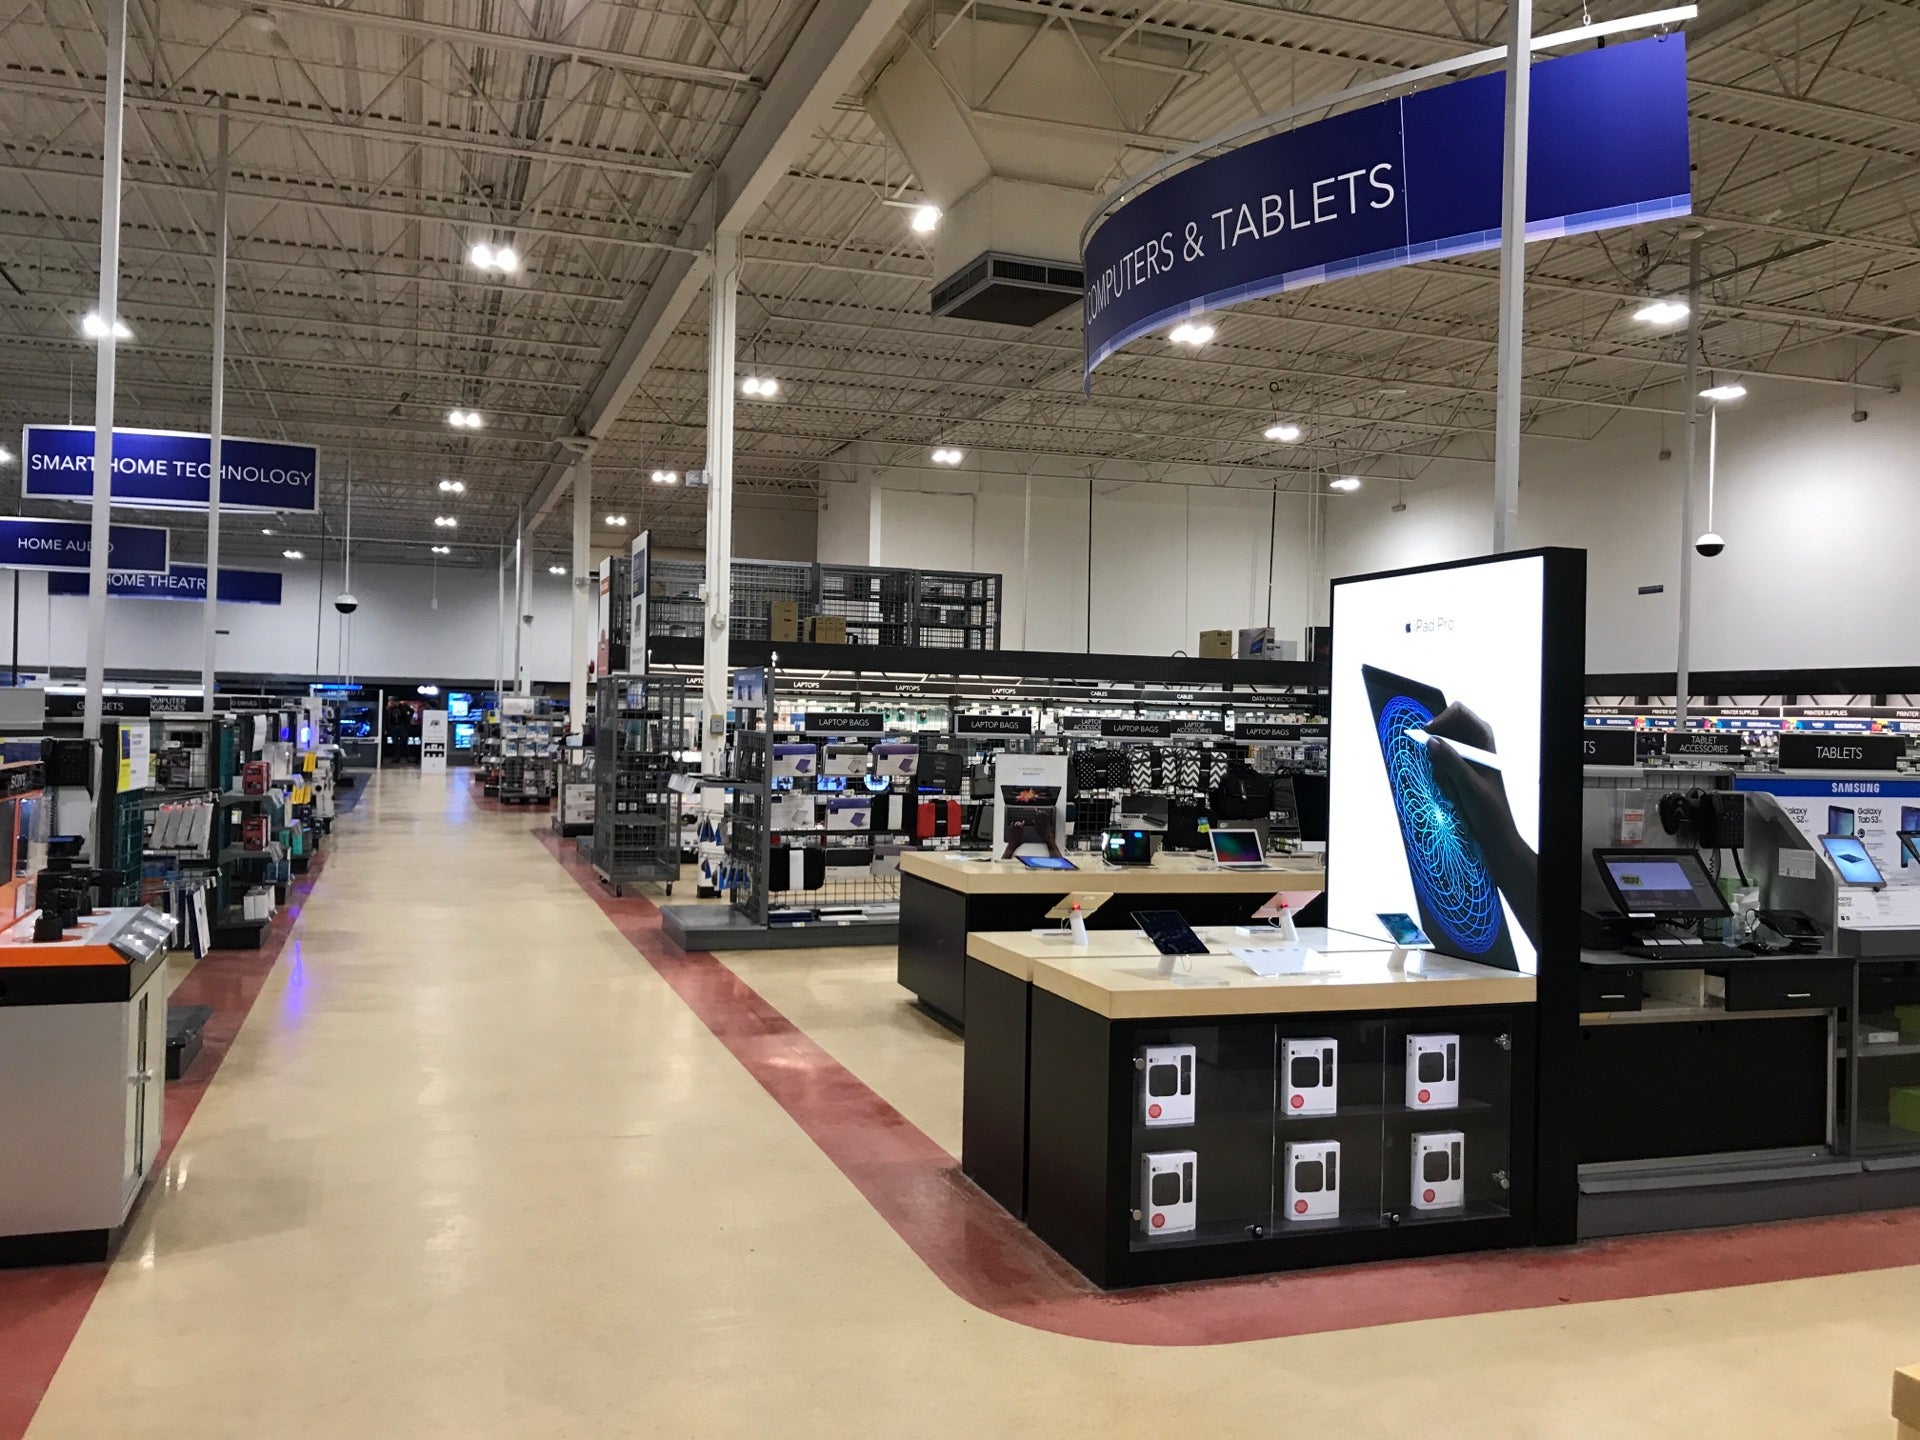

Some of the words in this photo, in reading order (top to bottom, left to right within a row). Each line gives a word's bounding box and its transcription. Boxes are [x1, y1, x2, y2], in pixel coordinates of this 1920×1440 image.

[1087, 231, 1174, 325] COMPUTERS
[1183, 221, 1205, 262] &
[1211, 162, 1396, 252] TABLETS
[31, 453, 95, 471] SMART
[172, 460, 312, 486] TECHNOLOGY
[18, 537, 62, 551] HOME
[148, 575, 207, 590] THEATR
[1413, 619, 1435, 633] iPad
[1437, 617, 1454, 631] Pro
[793, 681, 820, 689] LAPTOPS
[895, 684, 920, 692] LAPTOPS
[818, 718, 847, 727] LAPTOP
[849, 718, 870, 727] BAGS
[971, 720, 999, 729] LAPTOP
[1000, 721, 1019, 730] BAGS
[1113, 725, 1140, 733] LAPTOP
[1246, 728, 1271, 736] LAPTOP
[1691, 736, 1717, 744] TABLET
[1679, 744, 1729, 753] ACCESSORIES
[1816, 746, 1863, 760] TABLETS
[1831, 782, 1880, 793] SAMSUNG
[1857, 807, 1882, 817] Galaxy
